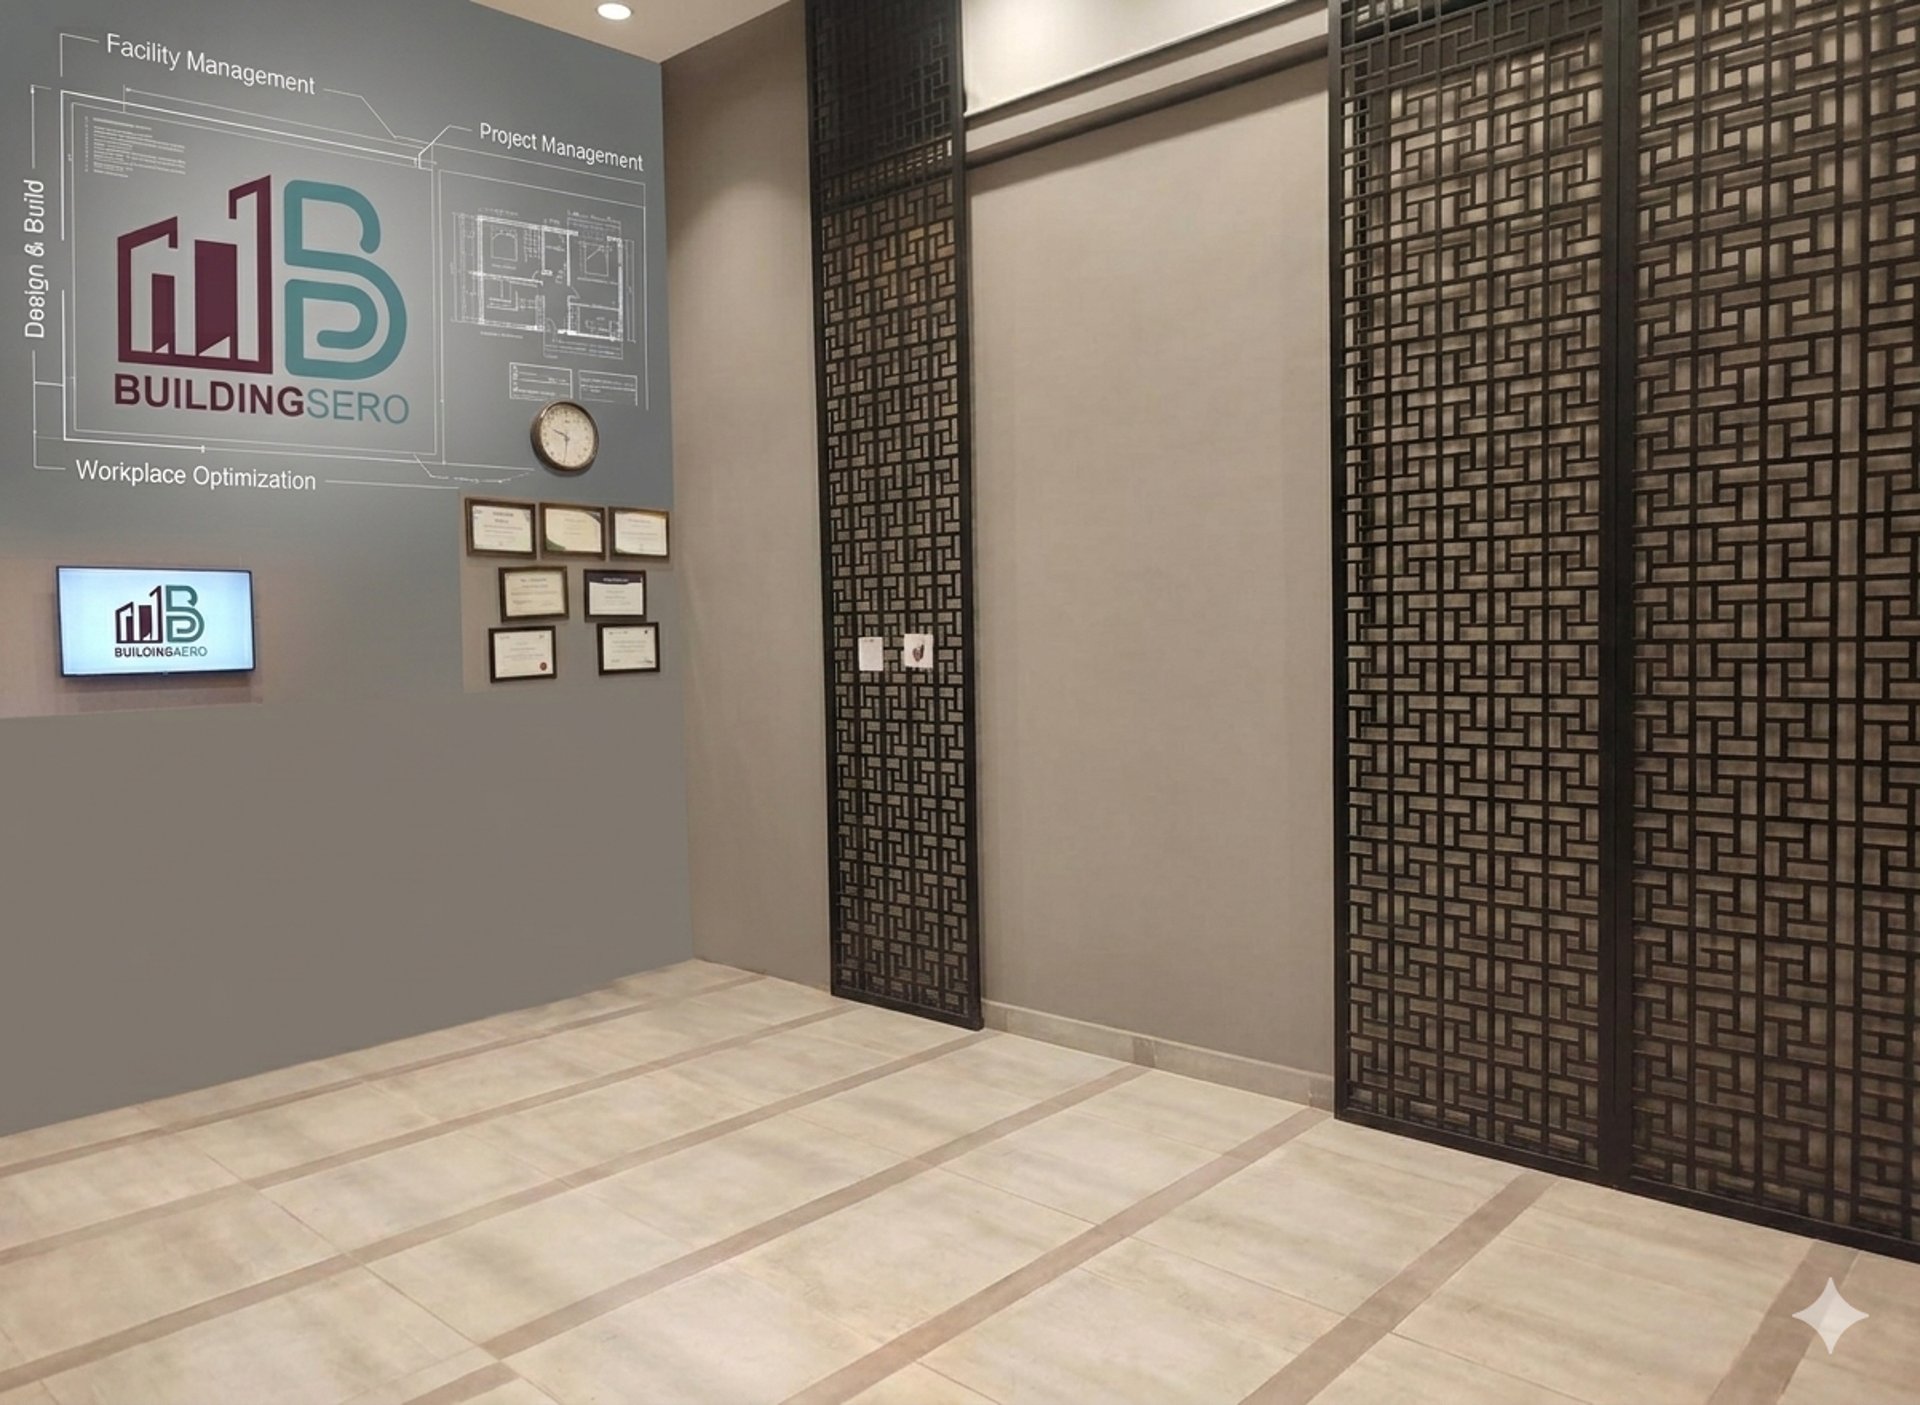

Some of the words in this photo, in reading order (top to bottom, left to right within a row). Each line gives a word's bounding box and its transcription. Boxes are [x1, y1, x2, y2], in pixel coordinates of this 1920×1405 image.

[106, 33, 181, 71] Facility
[186, 50, 316, 95] Management
[480, 122, 537, 150] Project
[542, 135, 644, 172] Management
[23, 179, 45, 233] Build
[23, 241, 45, 257] &
[76, 459, 186, 486] Workplace
[193, 465, 316, 490] Optimization
